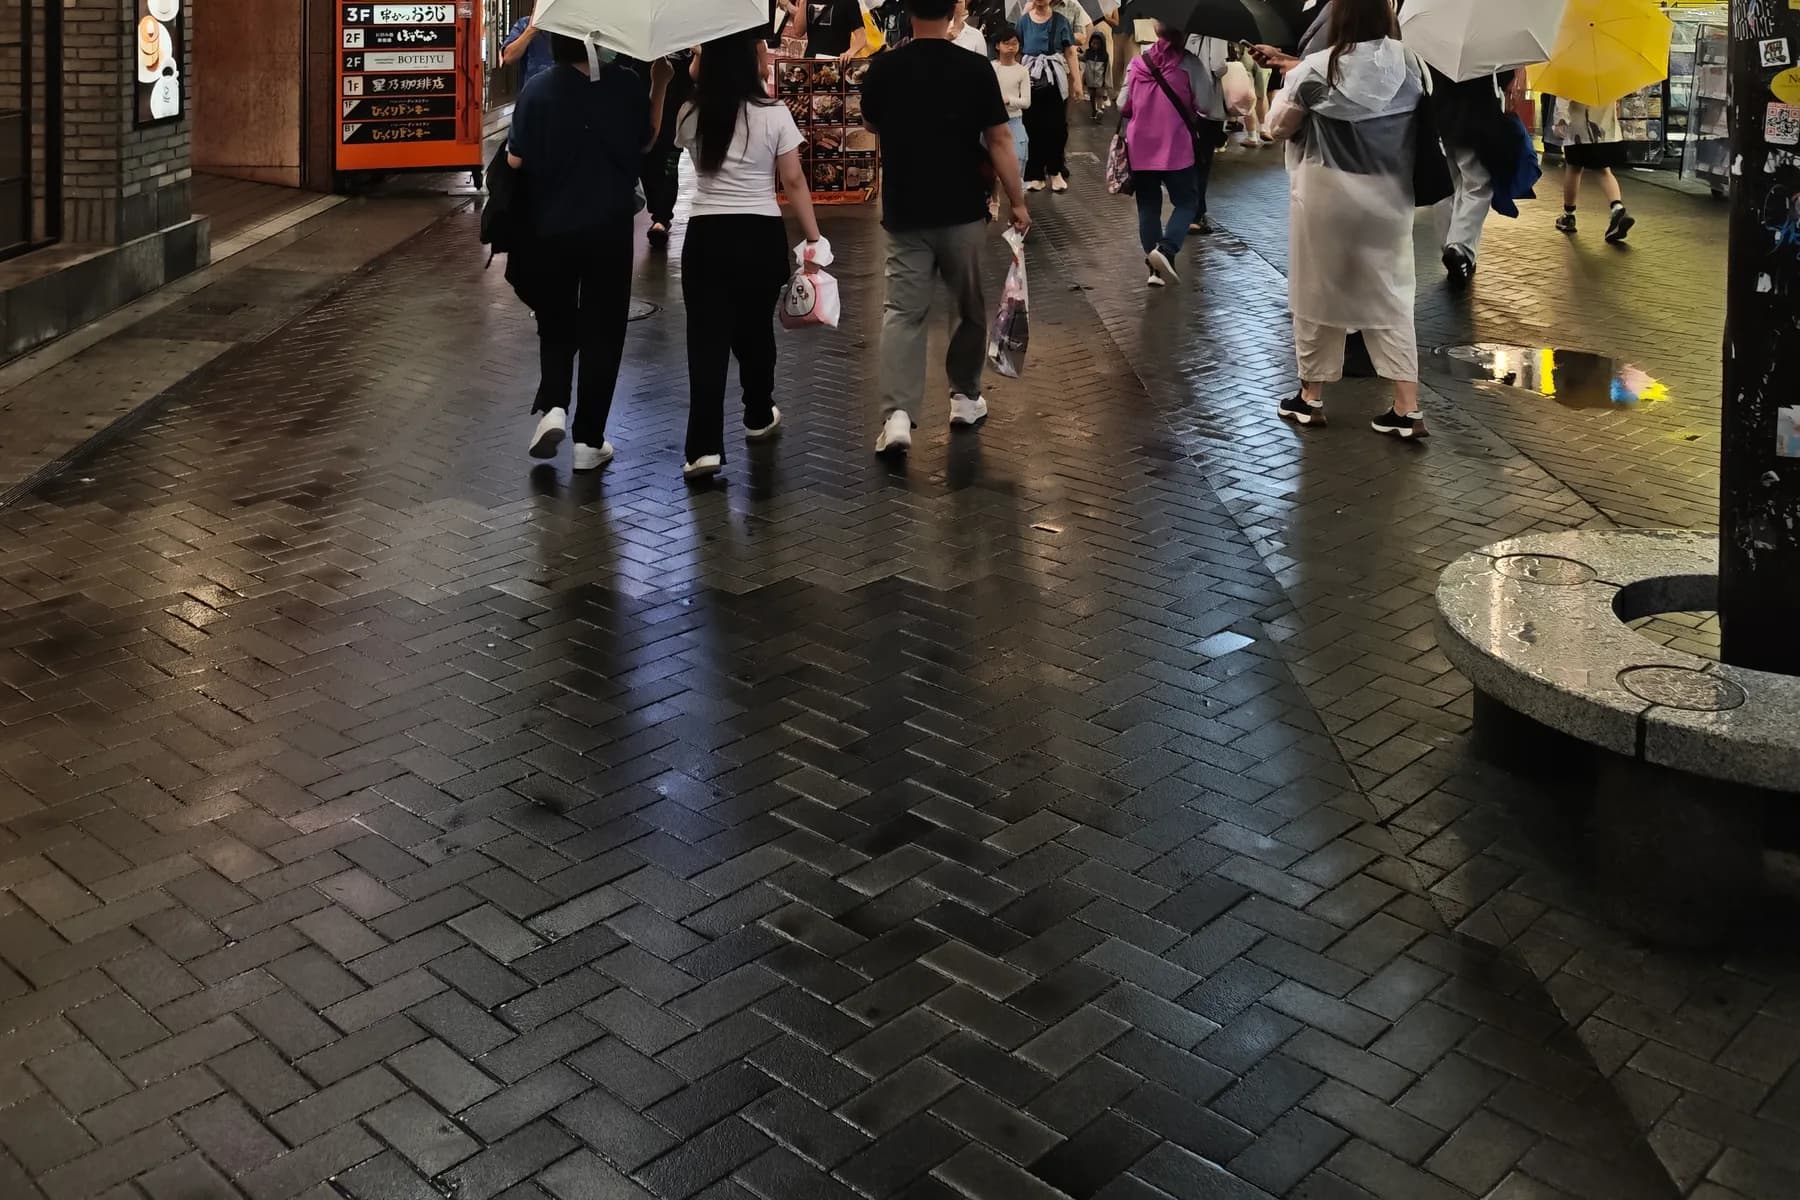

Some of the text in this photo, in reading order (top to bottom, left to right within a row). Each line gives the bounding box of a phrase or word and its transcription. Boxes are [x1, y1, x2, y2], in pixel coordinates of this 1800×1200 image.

[347, 7, 370, 22] 3F
[346, 33, 361, 43] 2F
[346, 57, 361, 68] 2F
[348, 76, 445, 92] 1F 星乃珈琲店
